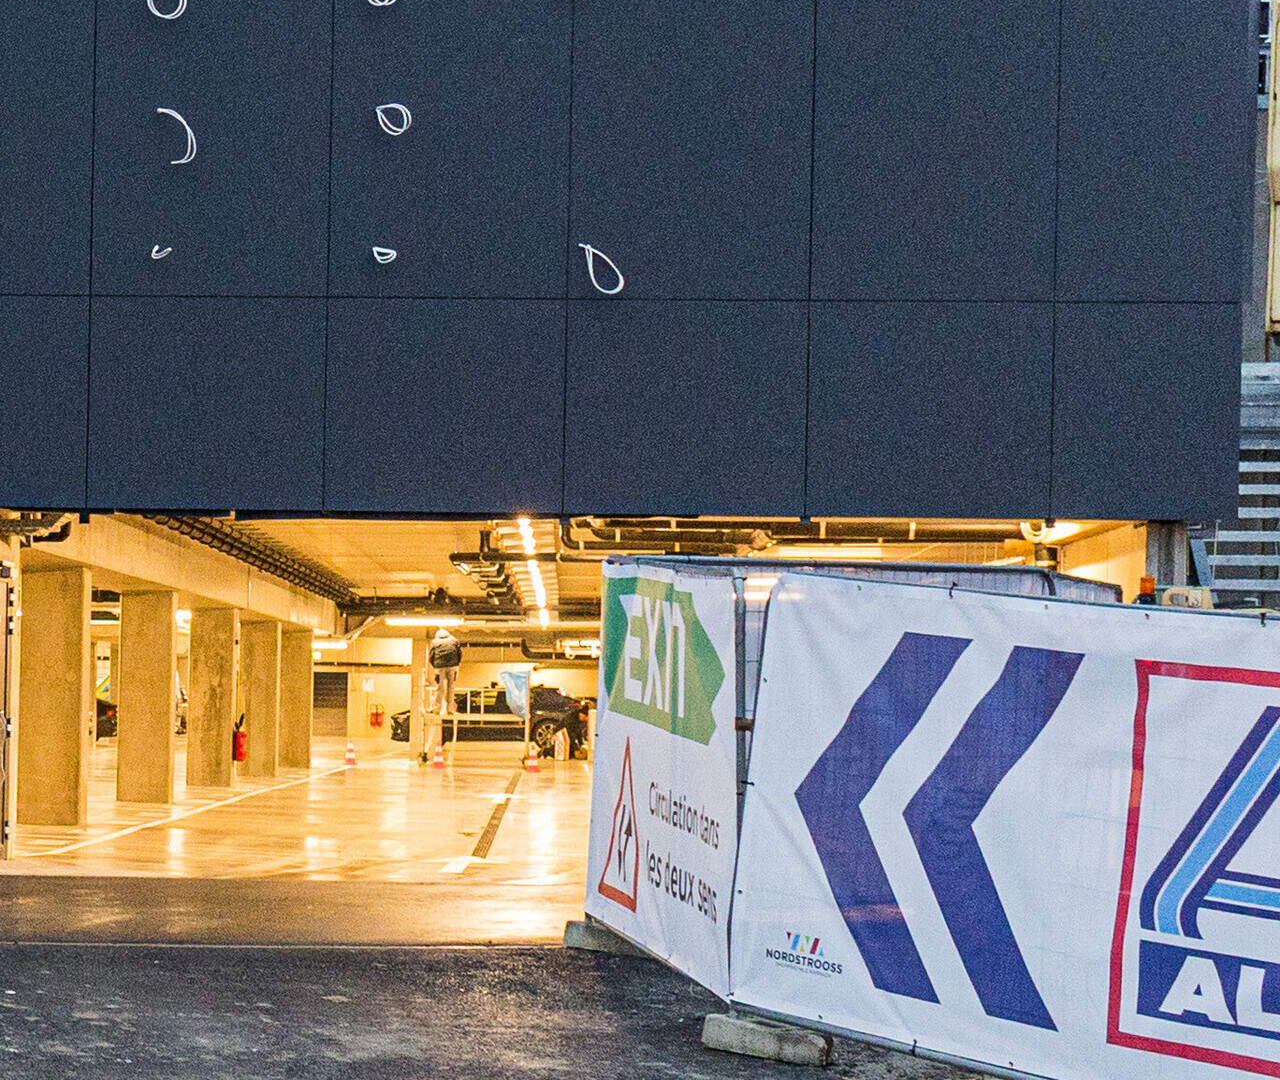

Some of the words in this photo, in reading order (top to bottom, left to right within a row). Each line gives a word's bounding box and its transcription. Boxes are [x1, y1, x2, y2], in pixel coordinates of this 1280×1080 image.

[649, 782, 699, 836] Circulation
[665, 852, 695, 907] deux
[766, 948, 843, 975] NORDSTROOSS
